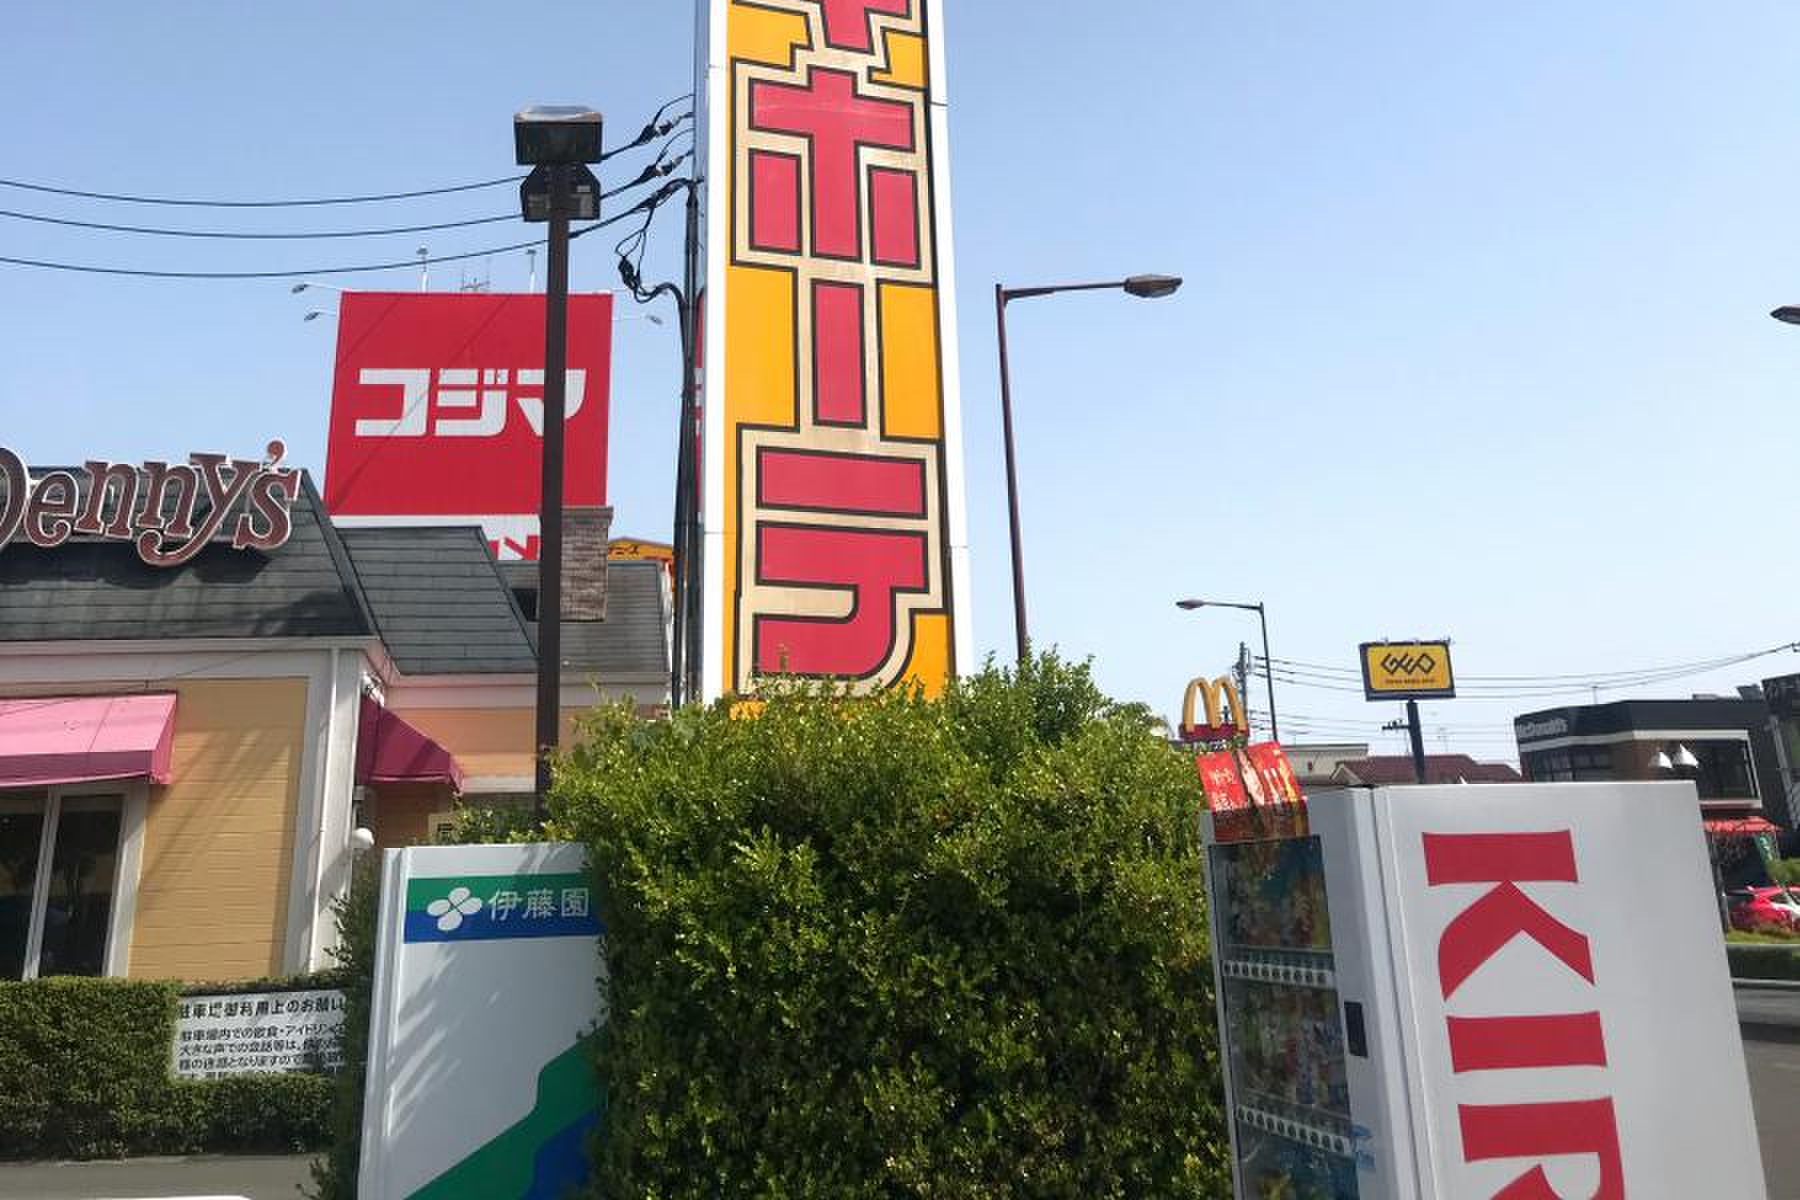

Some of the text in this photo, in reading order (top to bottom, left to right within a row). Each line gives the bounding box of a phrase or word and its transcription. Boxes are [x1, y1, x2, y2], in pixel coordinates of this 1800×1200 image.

[354, 367, 587, 437] コジマ
[487, 886, 591, 921] 伊藤園
